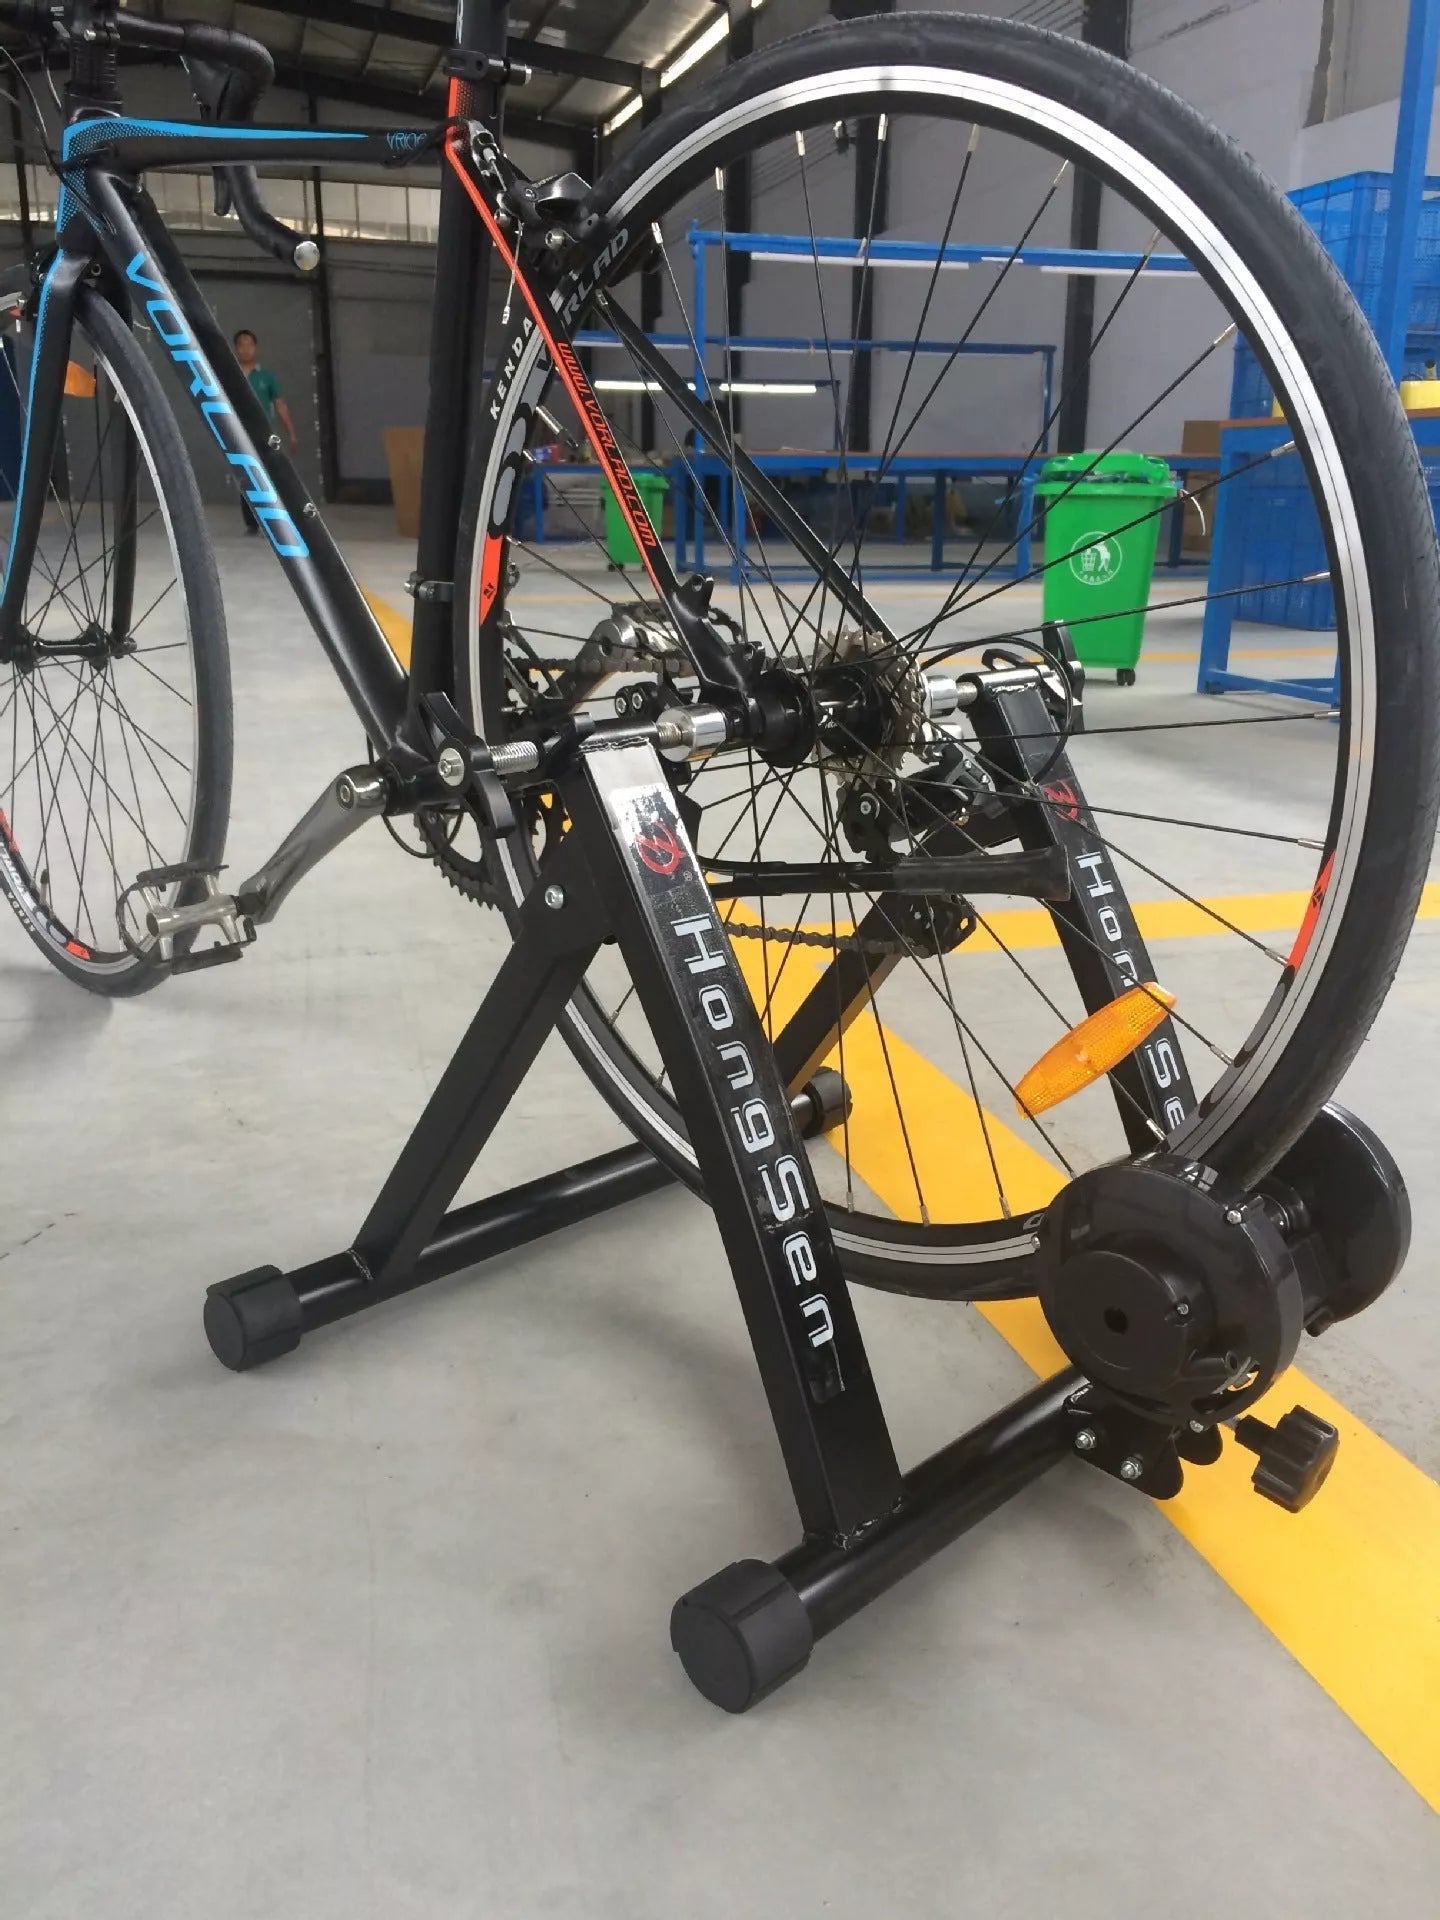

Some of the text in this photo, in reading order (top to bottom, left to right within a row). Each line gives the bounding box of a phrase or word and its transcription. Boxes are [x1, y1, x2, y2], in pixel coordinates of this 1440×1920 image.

[126, 252, 310, 558] VORLAD
[490, 316, 533, 421] KENDA
[556, 227, 629, 327] RLAD
[670, 912, 835, 1349] HongSen
[1075, 851, 1186, 1132] HonSe
